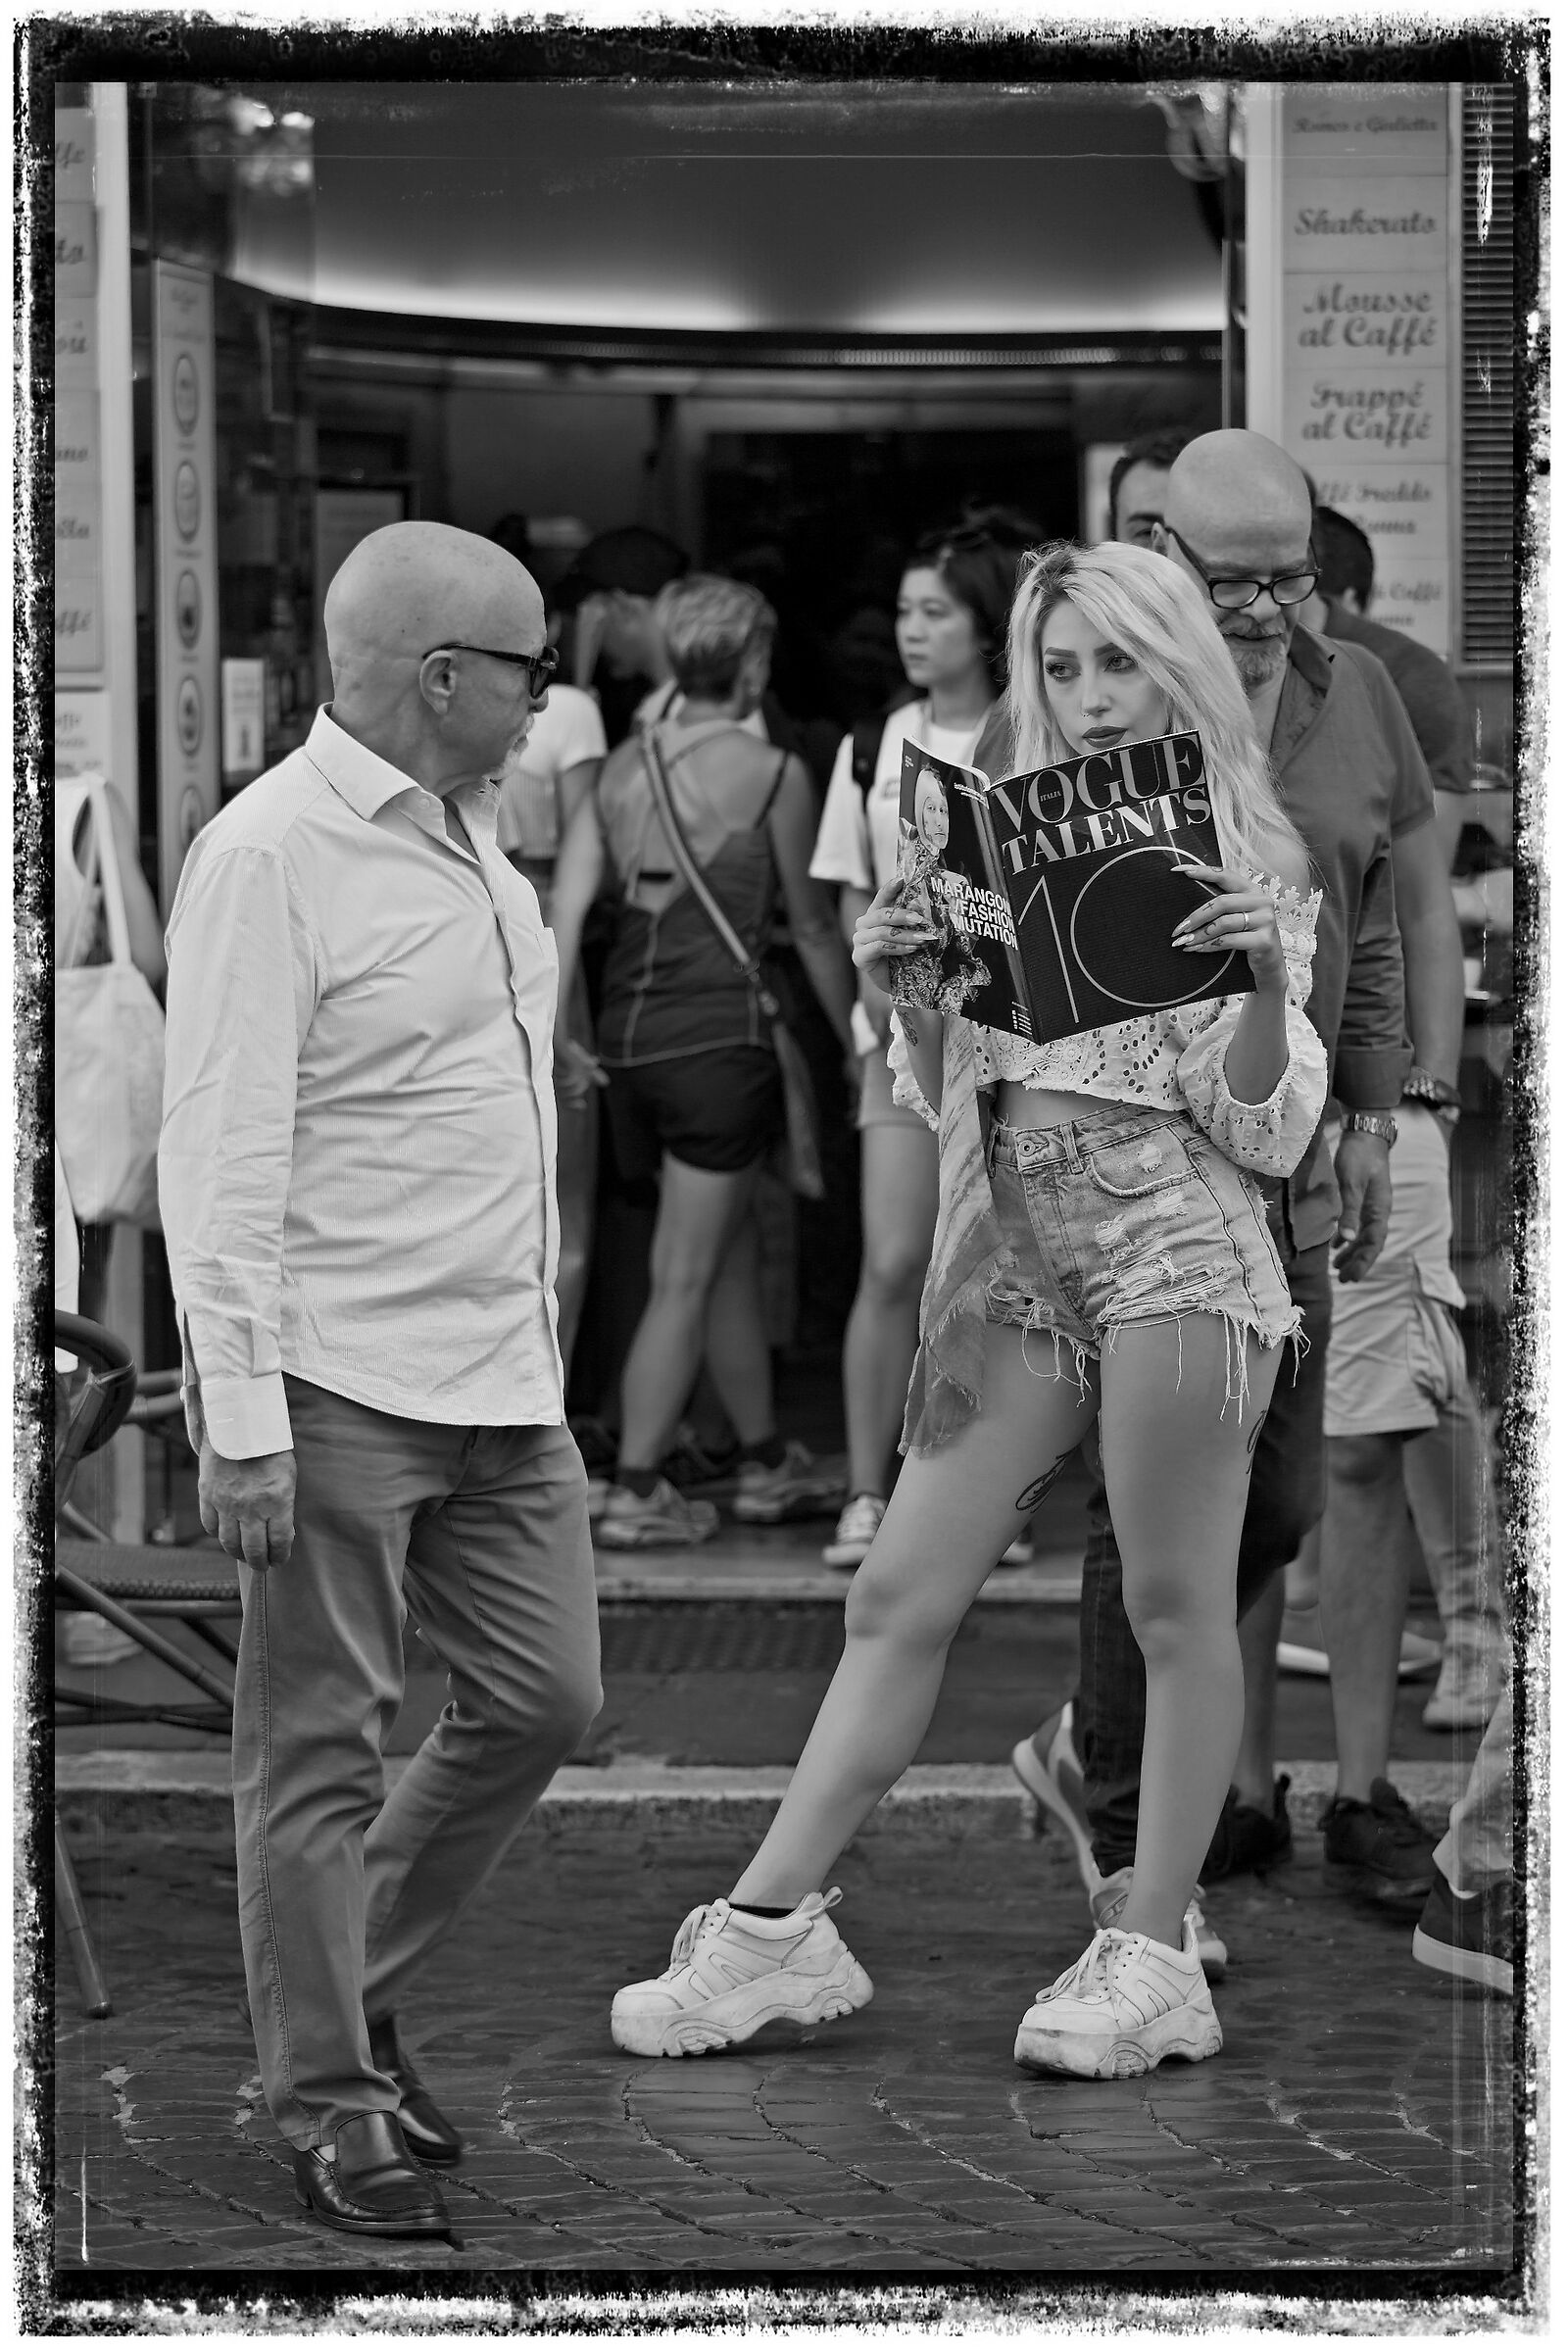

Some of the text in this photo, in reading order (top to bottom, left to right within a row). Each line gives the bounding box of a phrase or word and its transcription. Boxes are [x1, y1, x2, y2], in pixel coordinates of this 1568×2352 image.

[1294, 208, 1438, 235] Shakerato
[1302, 282, 1432, 314] Mousse
[1298, 317, 1337, 348] al
[1301, 412, 1339, 441] al
[990, 735, 1206, 833] VOGUE
[1040, 790, 1062, 803] ITALIA
[1002, 787, 1211, 875] TALENTS
[1017, 846, 1239, 1023] 10
